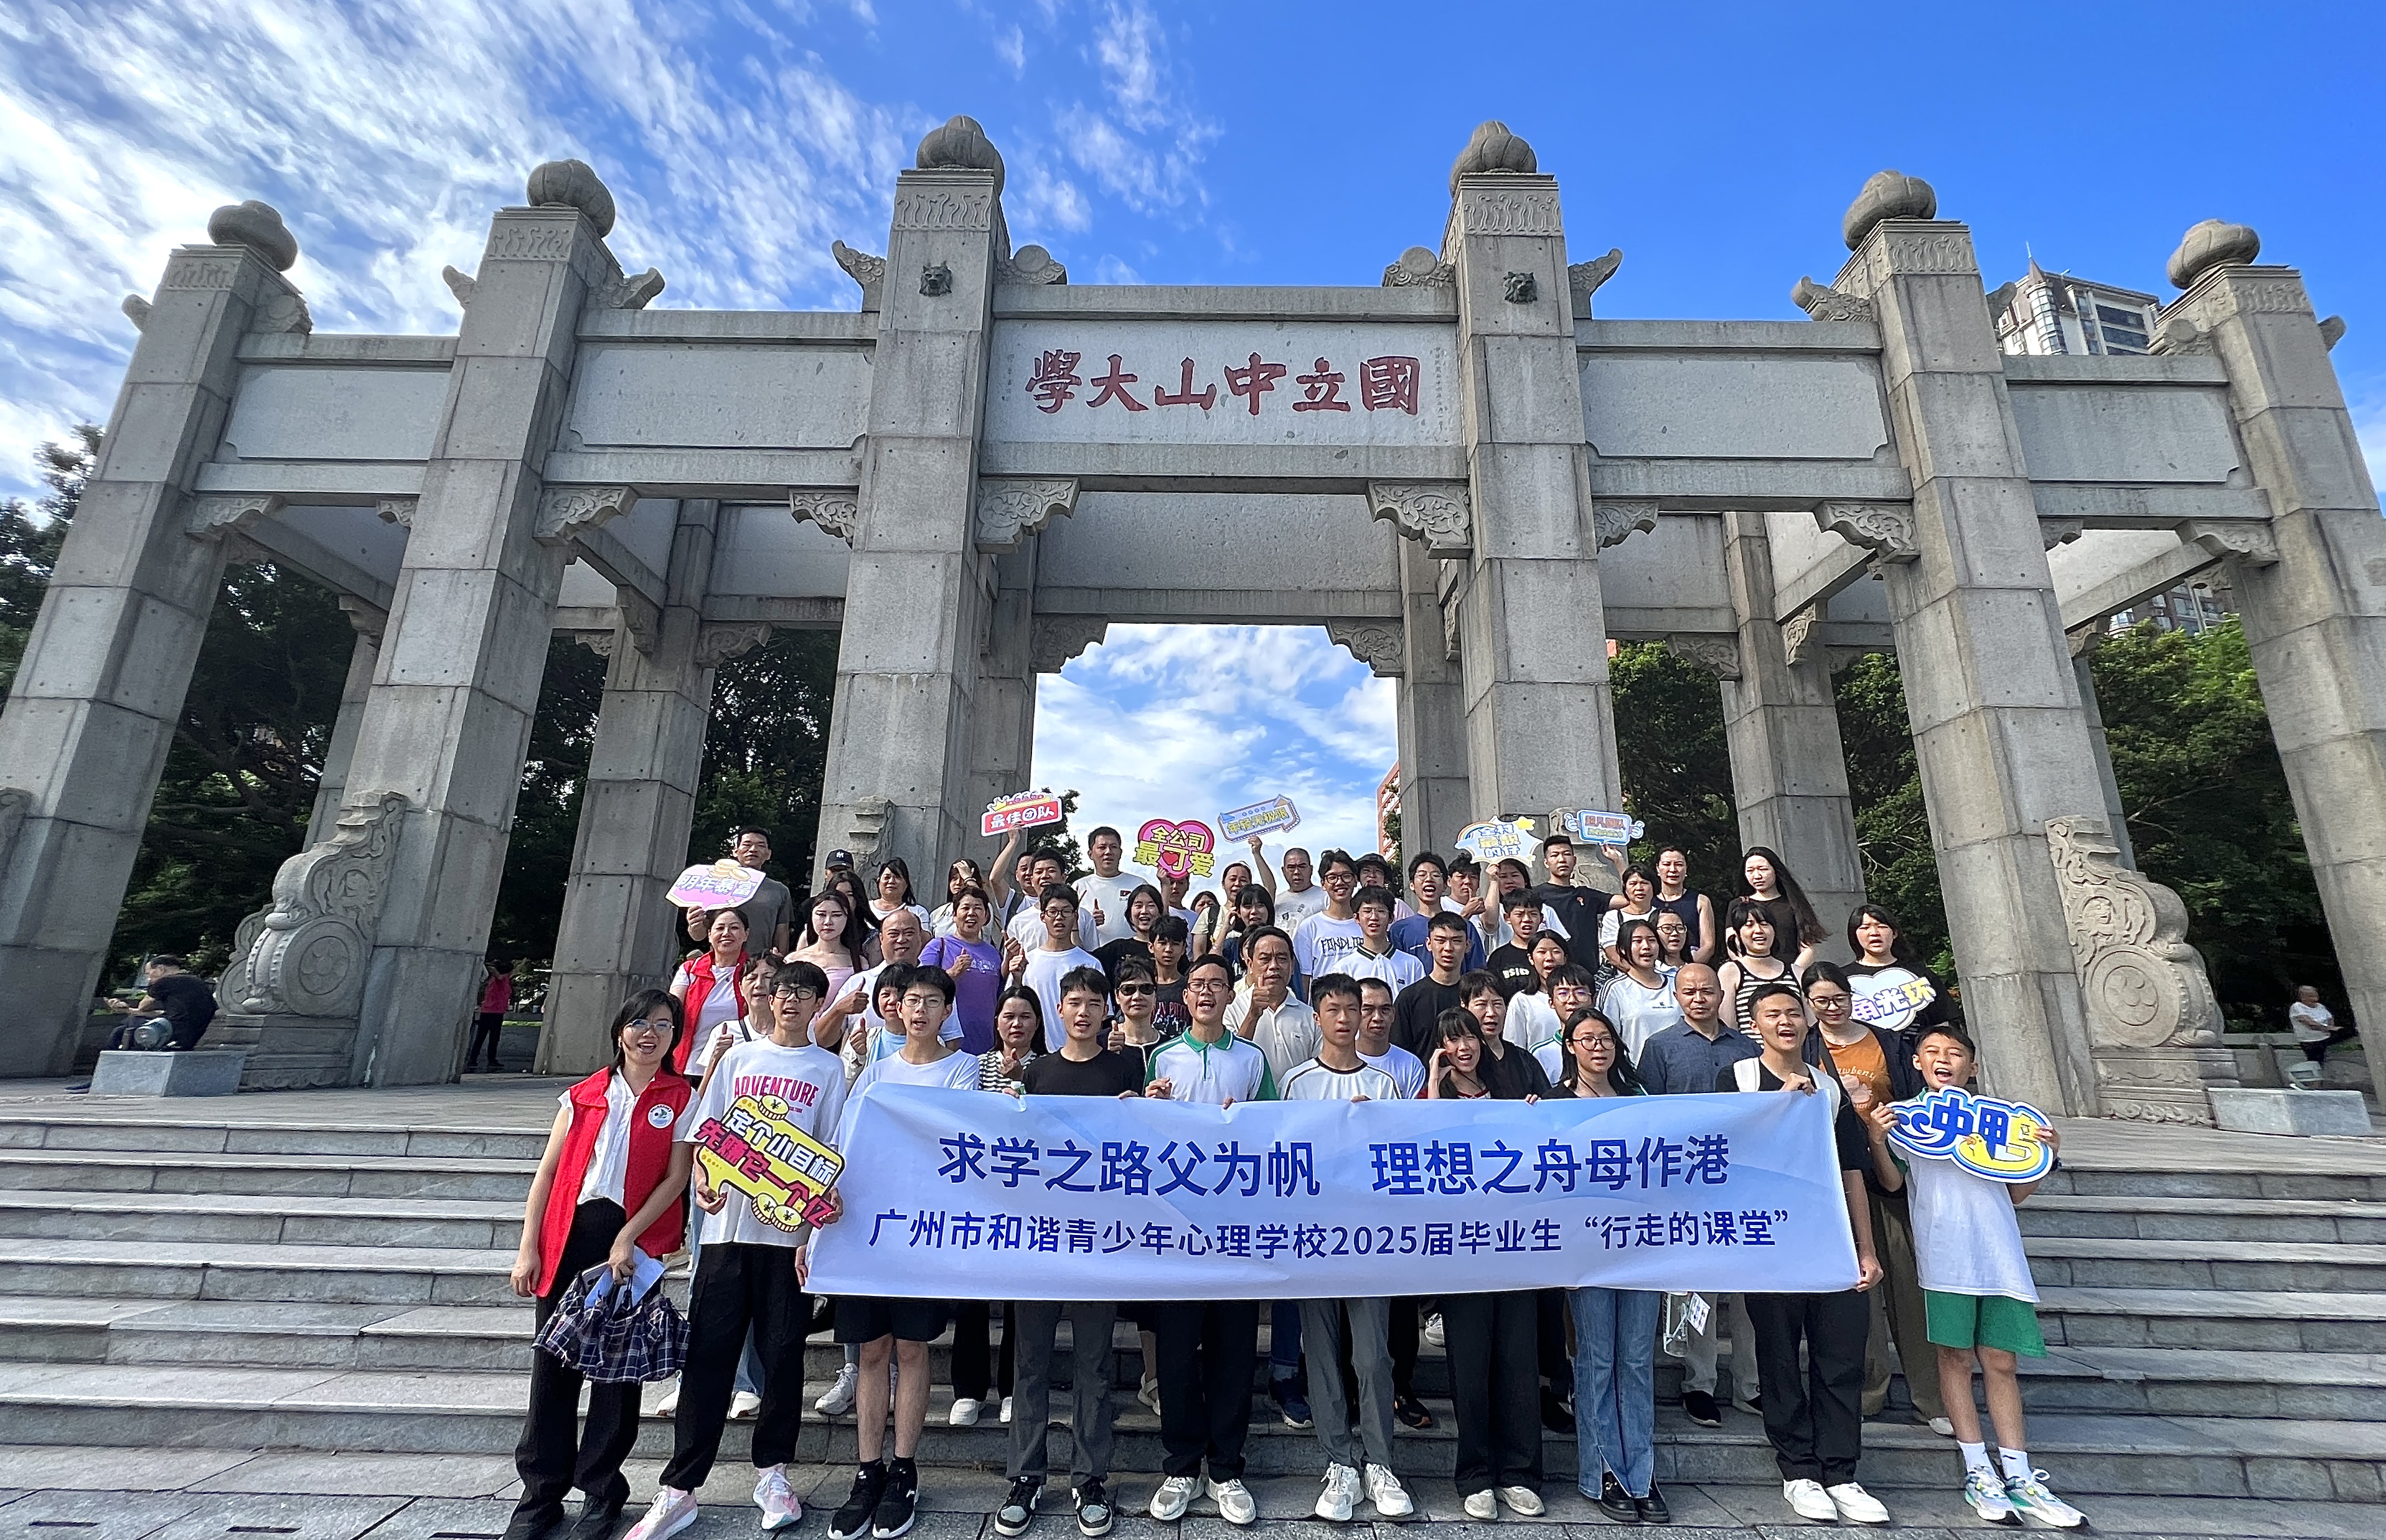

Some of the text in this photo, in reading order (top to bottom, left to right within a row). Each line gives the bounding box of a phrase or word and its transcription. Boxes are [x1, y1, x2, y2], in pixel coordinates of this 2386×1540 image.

[1025, 349, 1421, 416] 國立中山大學
[990, 805, 1055, 829] 最佳团队
[1151, 825, 1206, 851] 全公司
[1132, 840, 1215, 878] 最可爱
[676, 875, 757, 898] 明年暴富
[734, 1076, 819, 1107] ADVENTURE
[726, 1108, 838, 1186] 定个小目标
[937, 1132, 1729, 1198] 求学之路父为帆 理想之舟母作港
[694, 1117, 835, 1229] 先赚它一个亿
